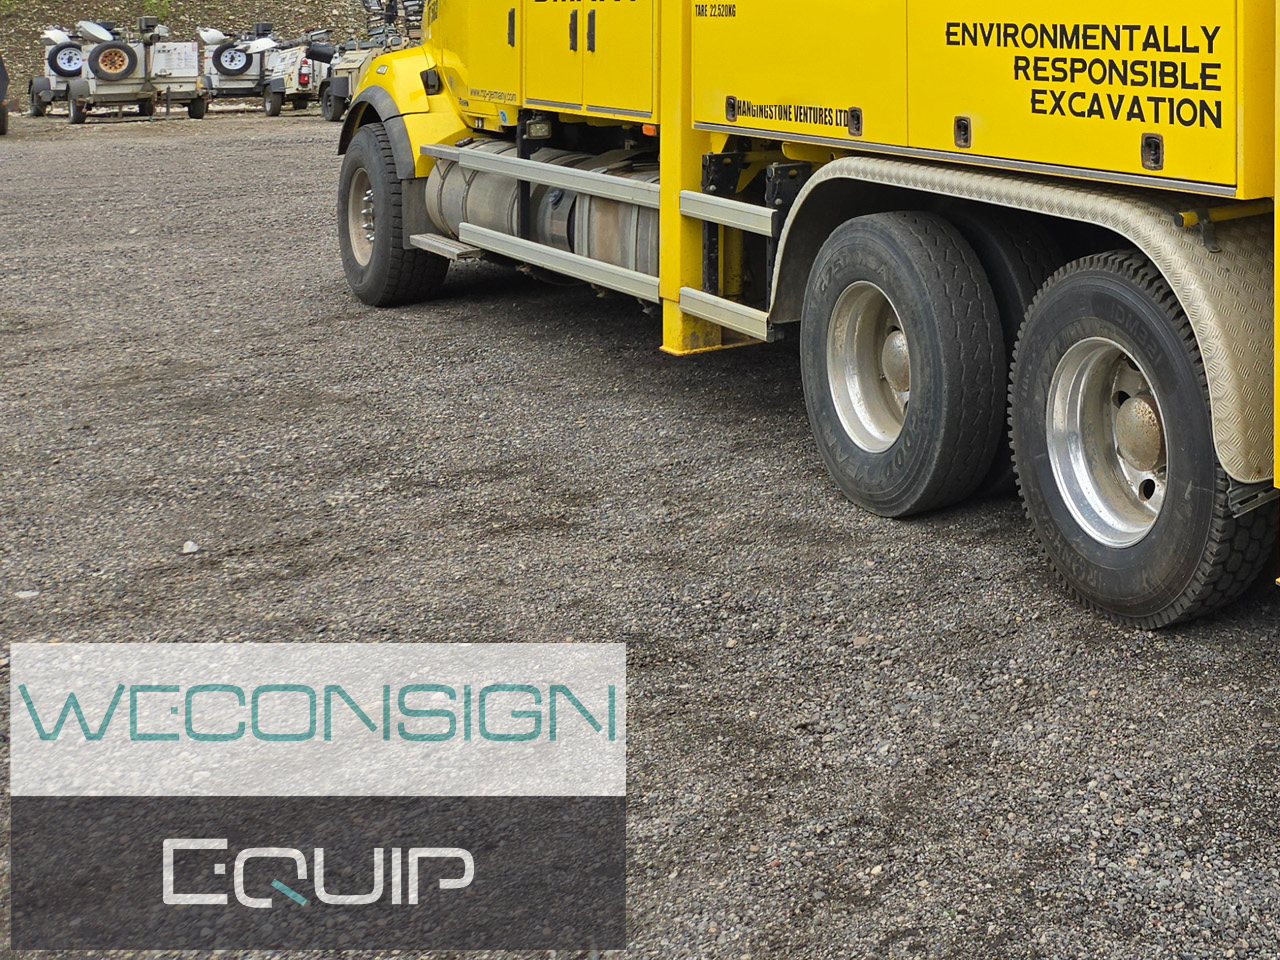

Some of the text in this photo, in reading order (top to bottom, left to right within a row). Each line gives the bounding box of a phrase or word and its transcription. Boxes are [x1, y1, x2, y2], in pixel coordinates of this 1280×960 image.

[695, 4, 708, 17] TARE
[945, 21, 1220, 54] ENVIRONMENTALLY
[1013, 55, 1222, 92] RESPONSIBLE
[737, 100, 793, 122] HANGINGSTONE
[793, 105, 834, 126] VENTURES
[1030, 88, 1222, 129] EXCAVATION
